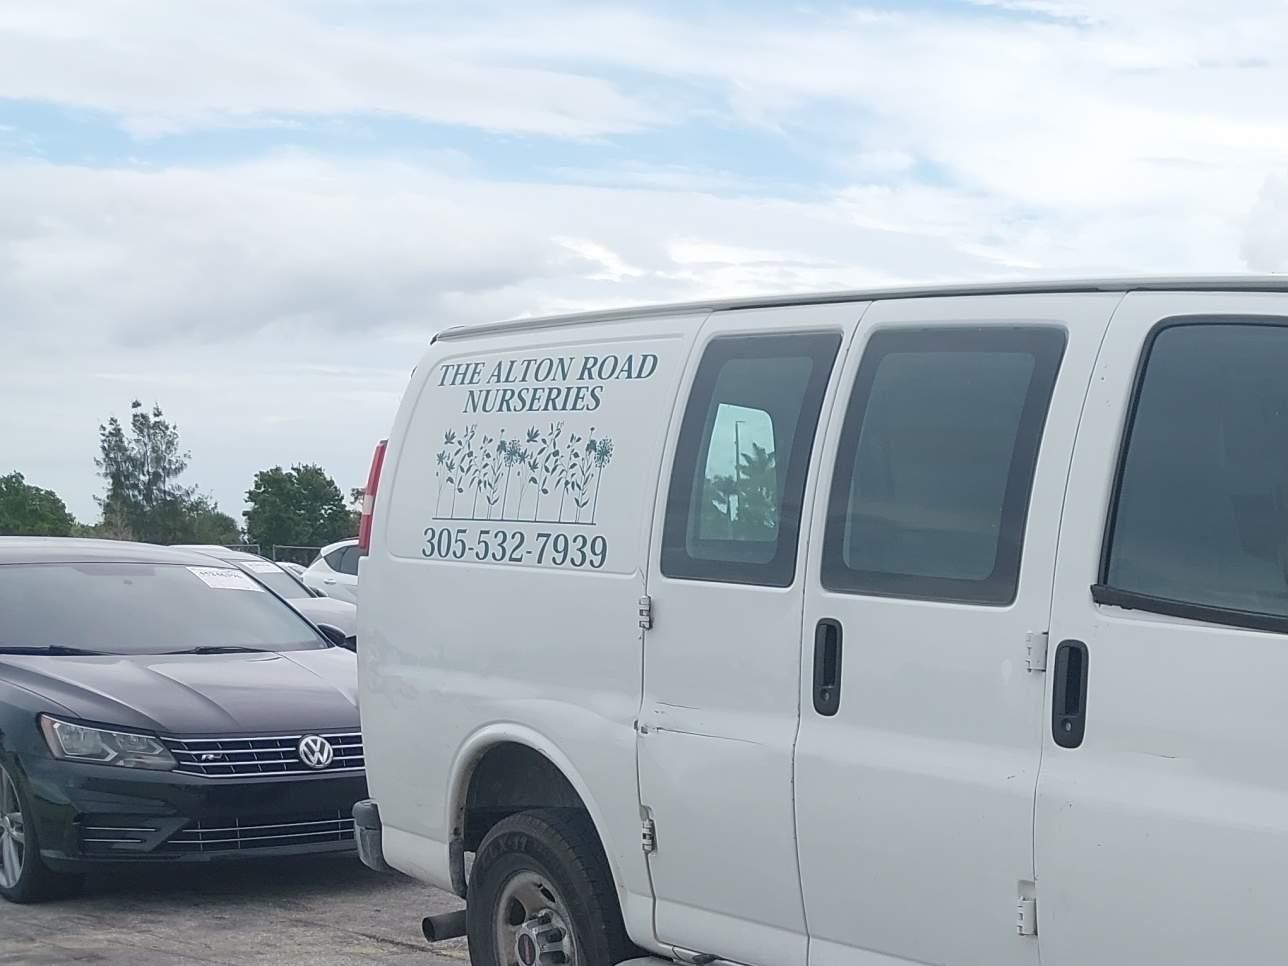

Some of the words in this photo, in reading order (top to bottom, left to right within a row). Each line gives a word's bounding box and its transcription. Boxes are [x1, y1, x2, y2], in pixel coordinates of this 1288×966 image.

[437, 362, 485, 387] THE
[486, 357, 575, 384] ALTON
[576, 353, 659, 381] ROAD
[462, 385, 604, 414] NURSERIES
[421, 527, 608, 569] 305-532-7939
